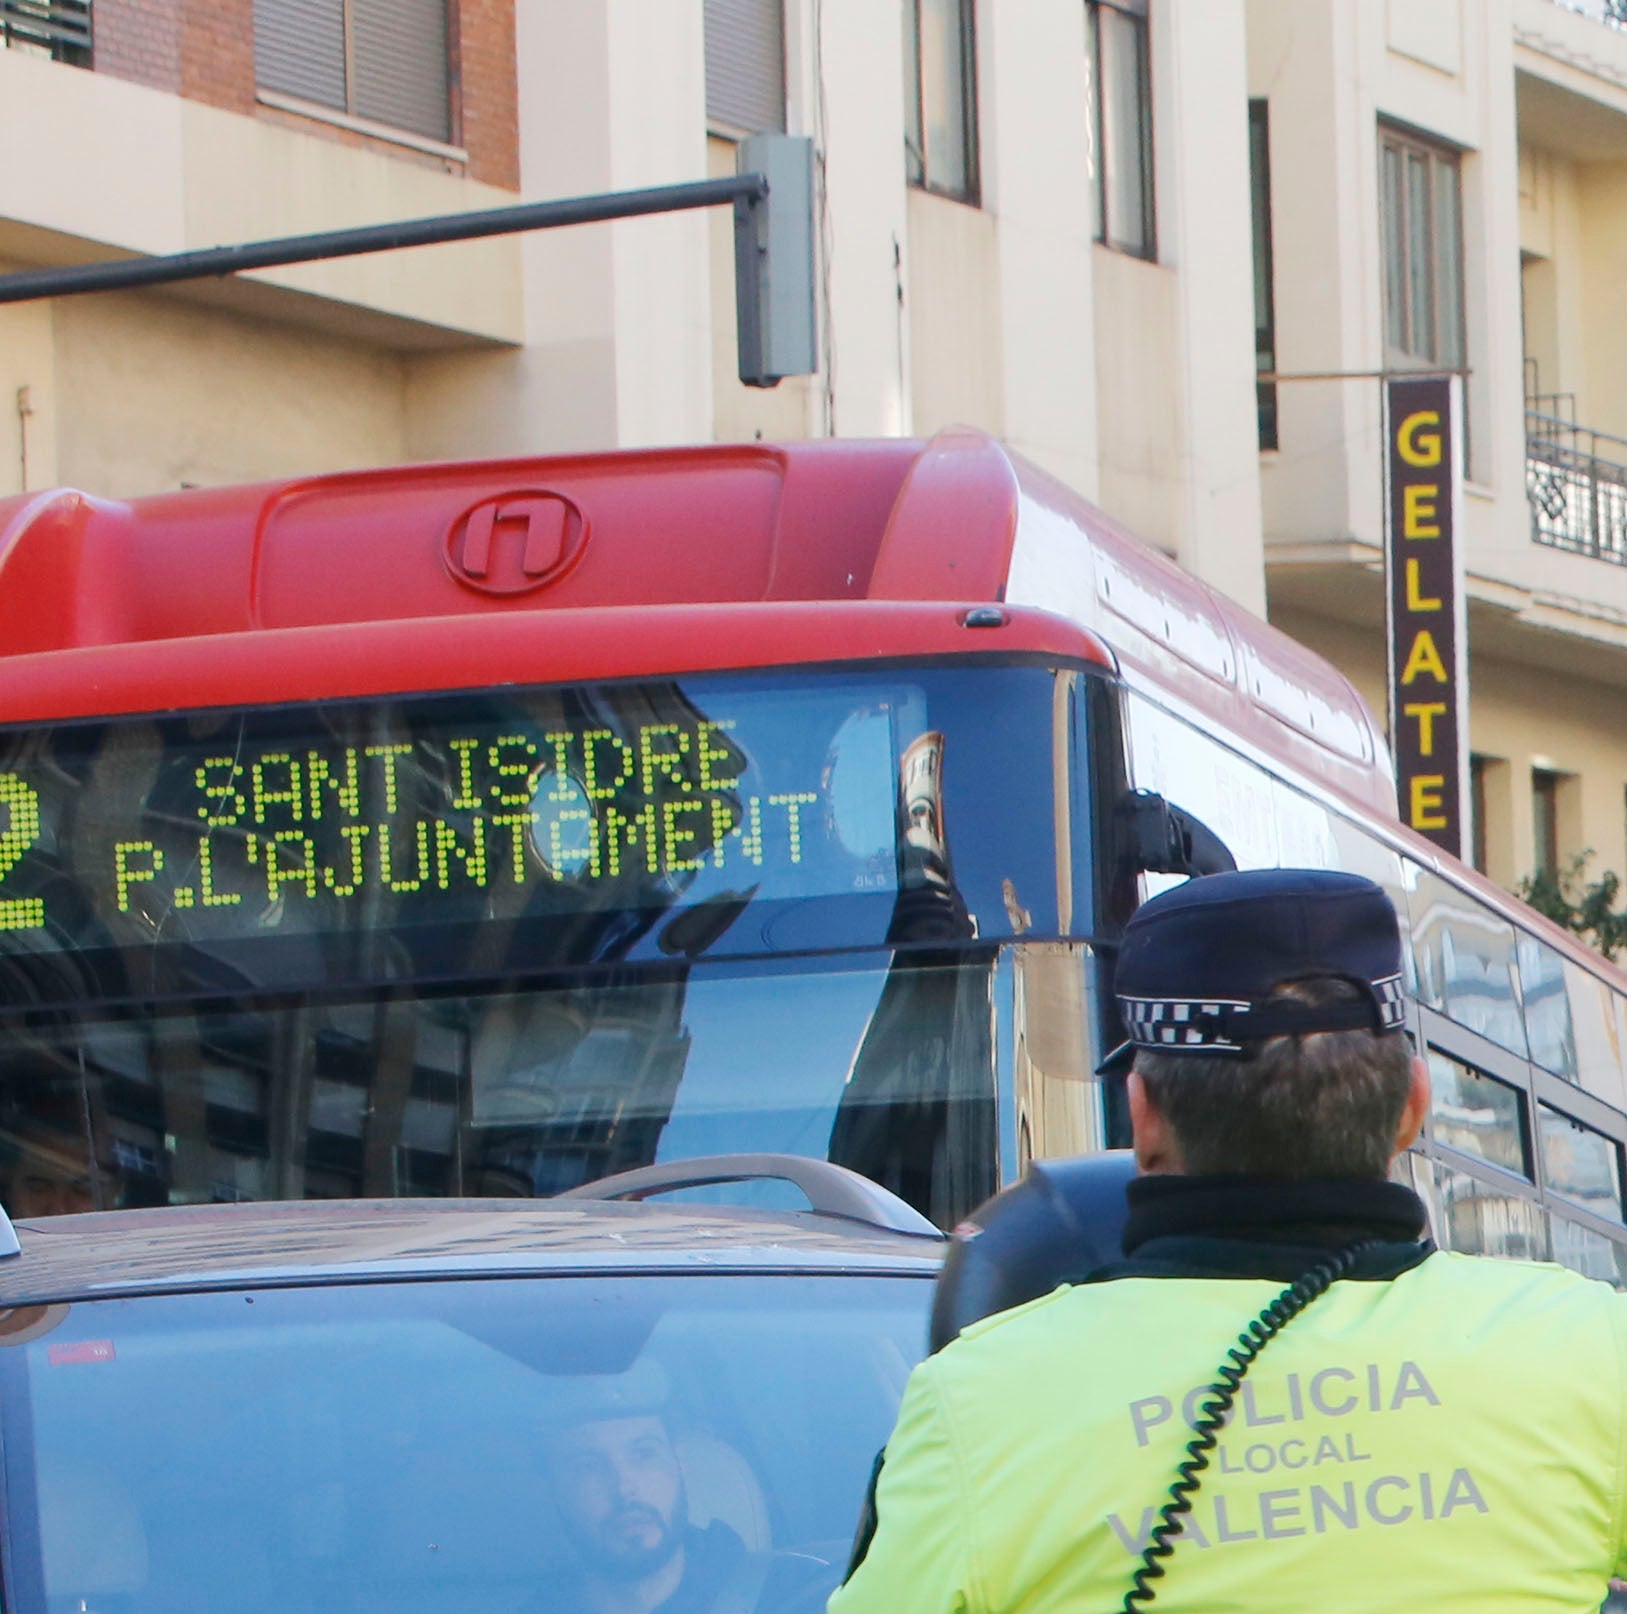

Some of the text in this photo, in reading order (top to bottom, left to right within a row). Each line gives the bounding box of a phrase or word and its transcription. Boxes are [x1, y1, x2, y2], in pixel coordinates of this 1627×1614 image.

[195, 720, 740, 824] SANT ISIDRE
[114, 792, 817, 912] P.L'AJUNTAMENT
[1129, 1360, 1441, 1448] POLICIA
[1219, 1432, 1371, 1475] LOCAL
[1106, 1467, 1490, 1557] VALENCIA
